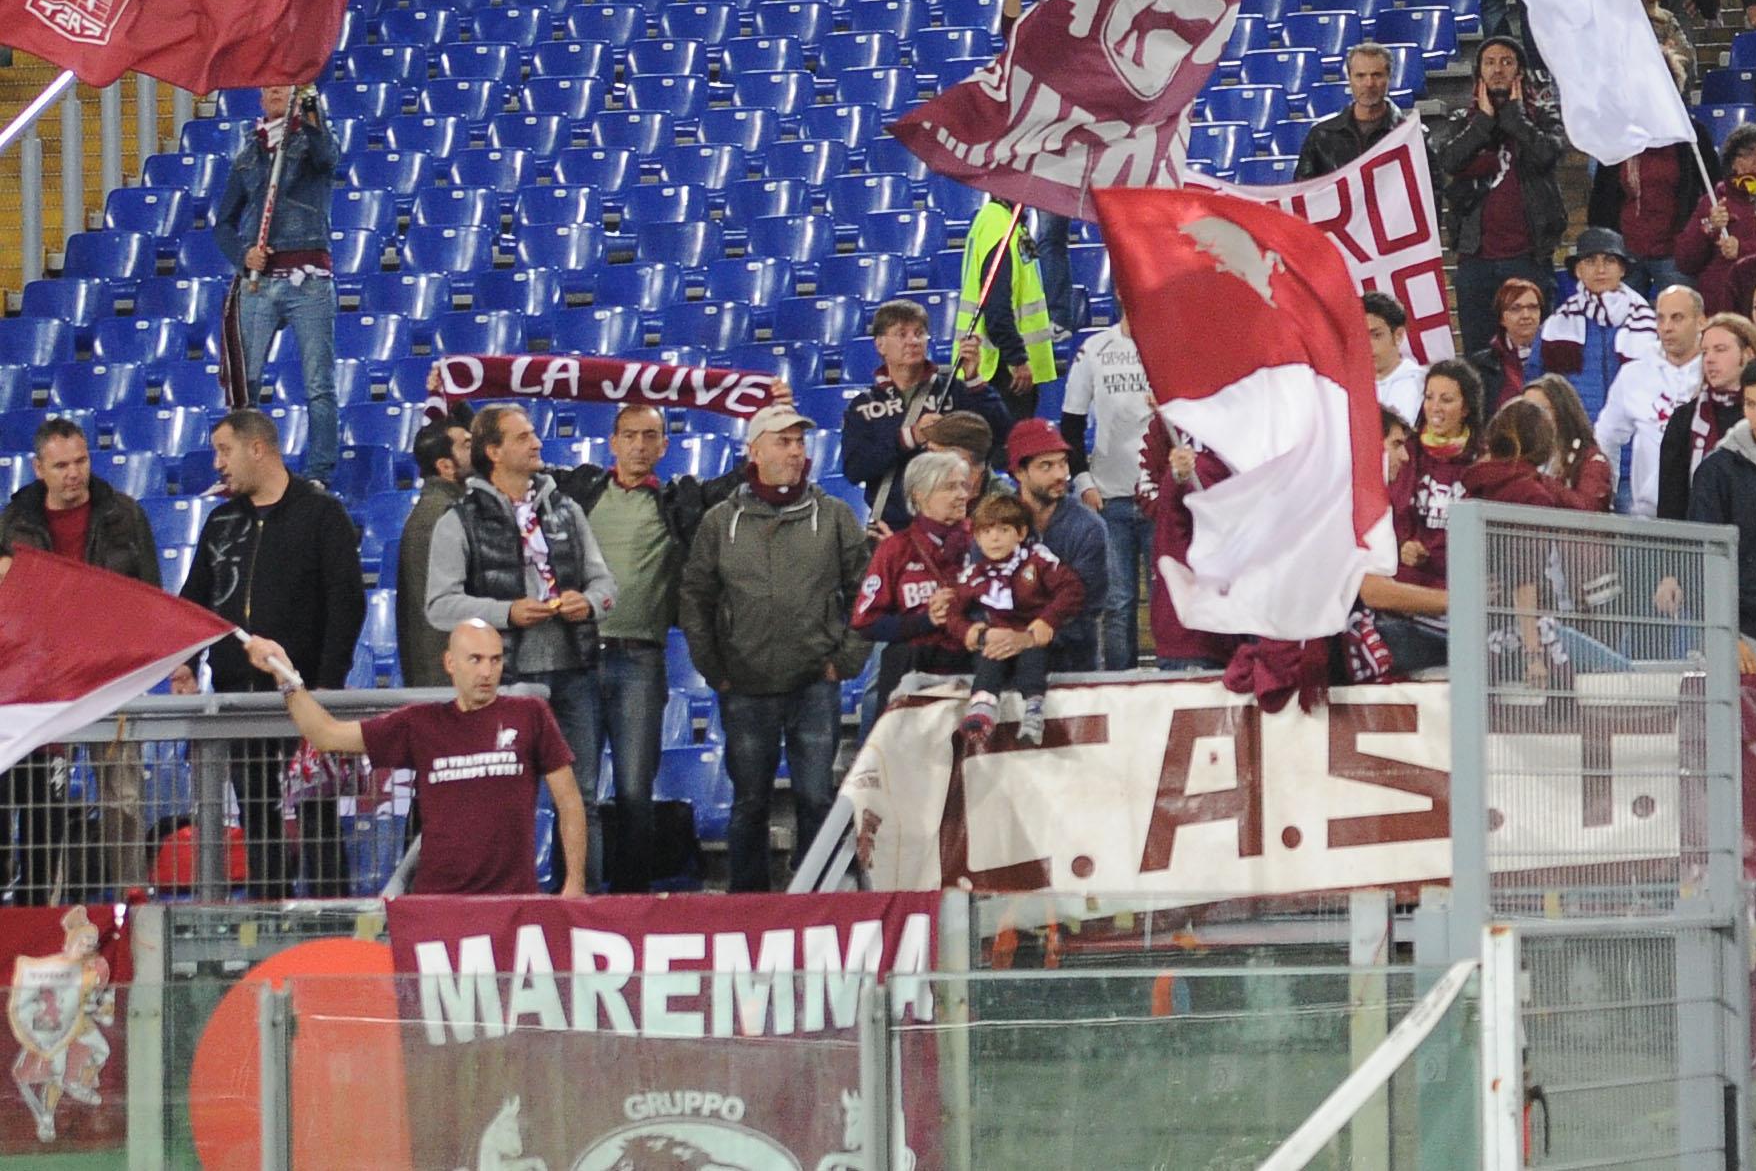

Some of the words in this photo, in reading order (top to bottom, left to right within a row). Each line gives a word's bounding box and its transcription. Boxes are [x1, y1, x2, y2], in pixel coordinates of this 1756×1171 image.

[511, 356, 580, 397] LA
[602, 362, 774, 412] JUVE
[413, 913, 935, 1047] MAREMMA
[624, 1090, 745, 1123] GRUPPO
